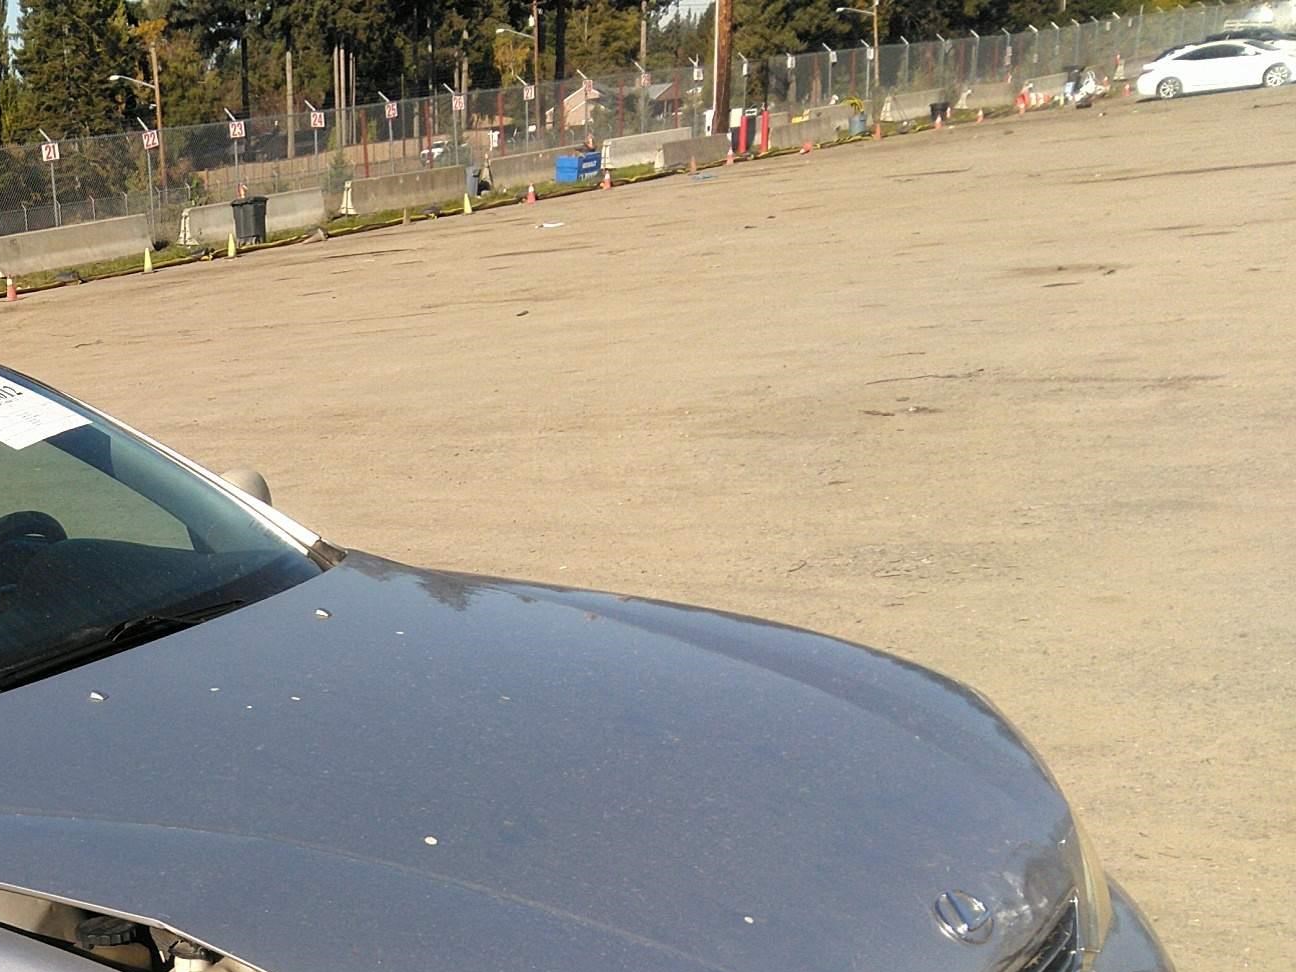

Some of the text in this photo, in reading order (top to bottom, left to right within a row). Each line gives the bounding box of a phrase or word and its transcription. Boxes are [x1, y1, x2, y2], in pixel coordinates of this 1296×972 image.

[387, 103, 397, 117] 25
[454, 96, 464, 110] 26
[313, 113, 324, 126] 24
[231, 122, 244, 137] 23
[144, 133, 157, 147] 22
[45, 145, 57, 161] 21
